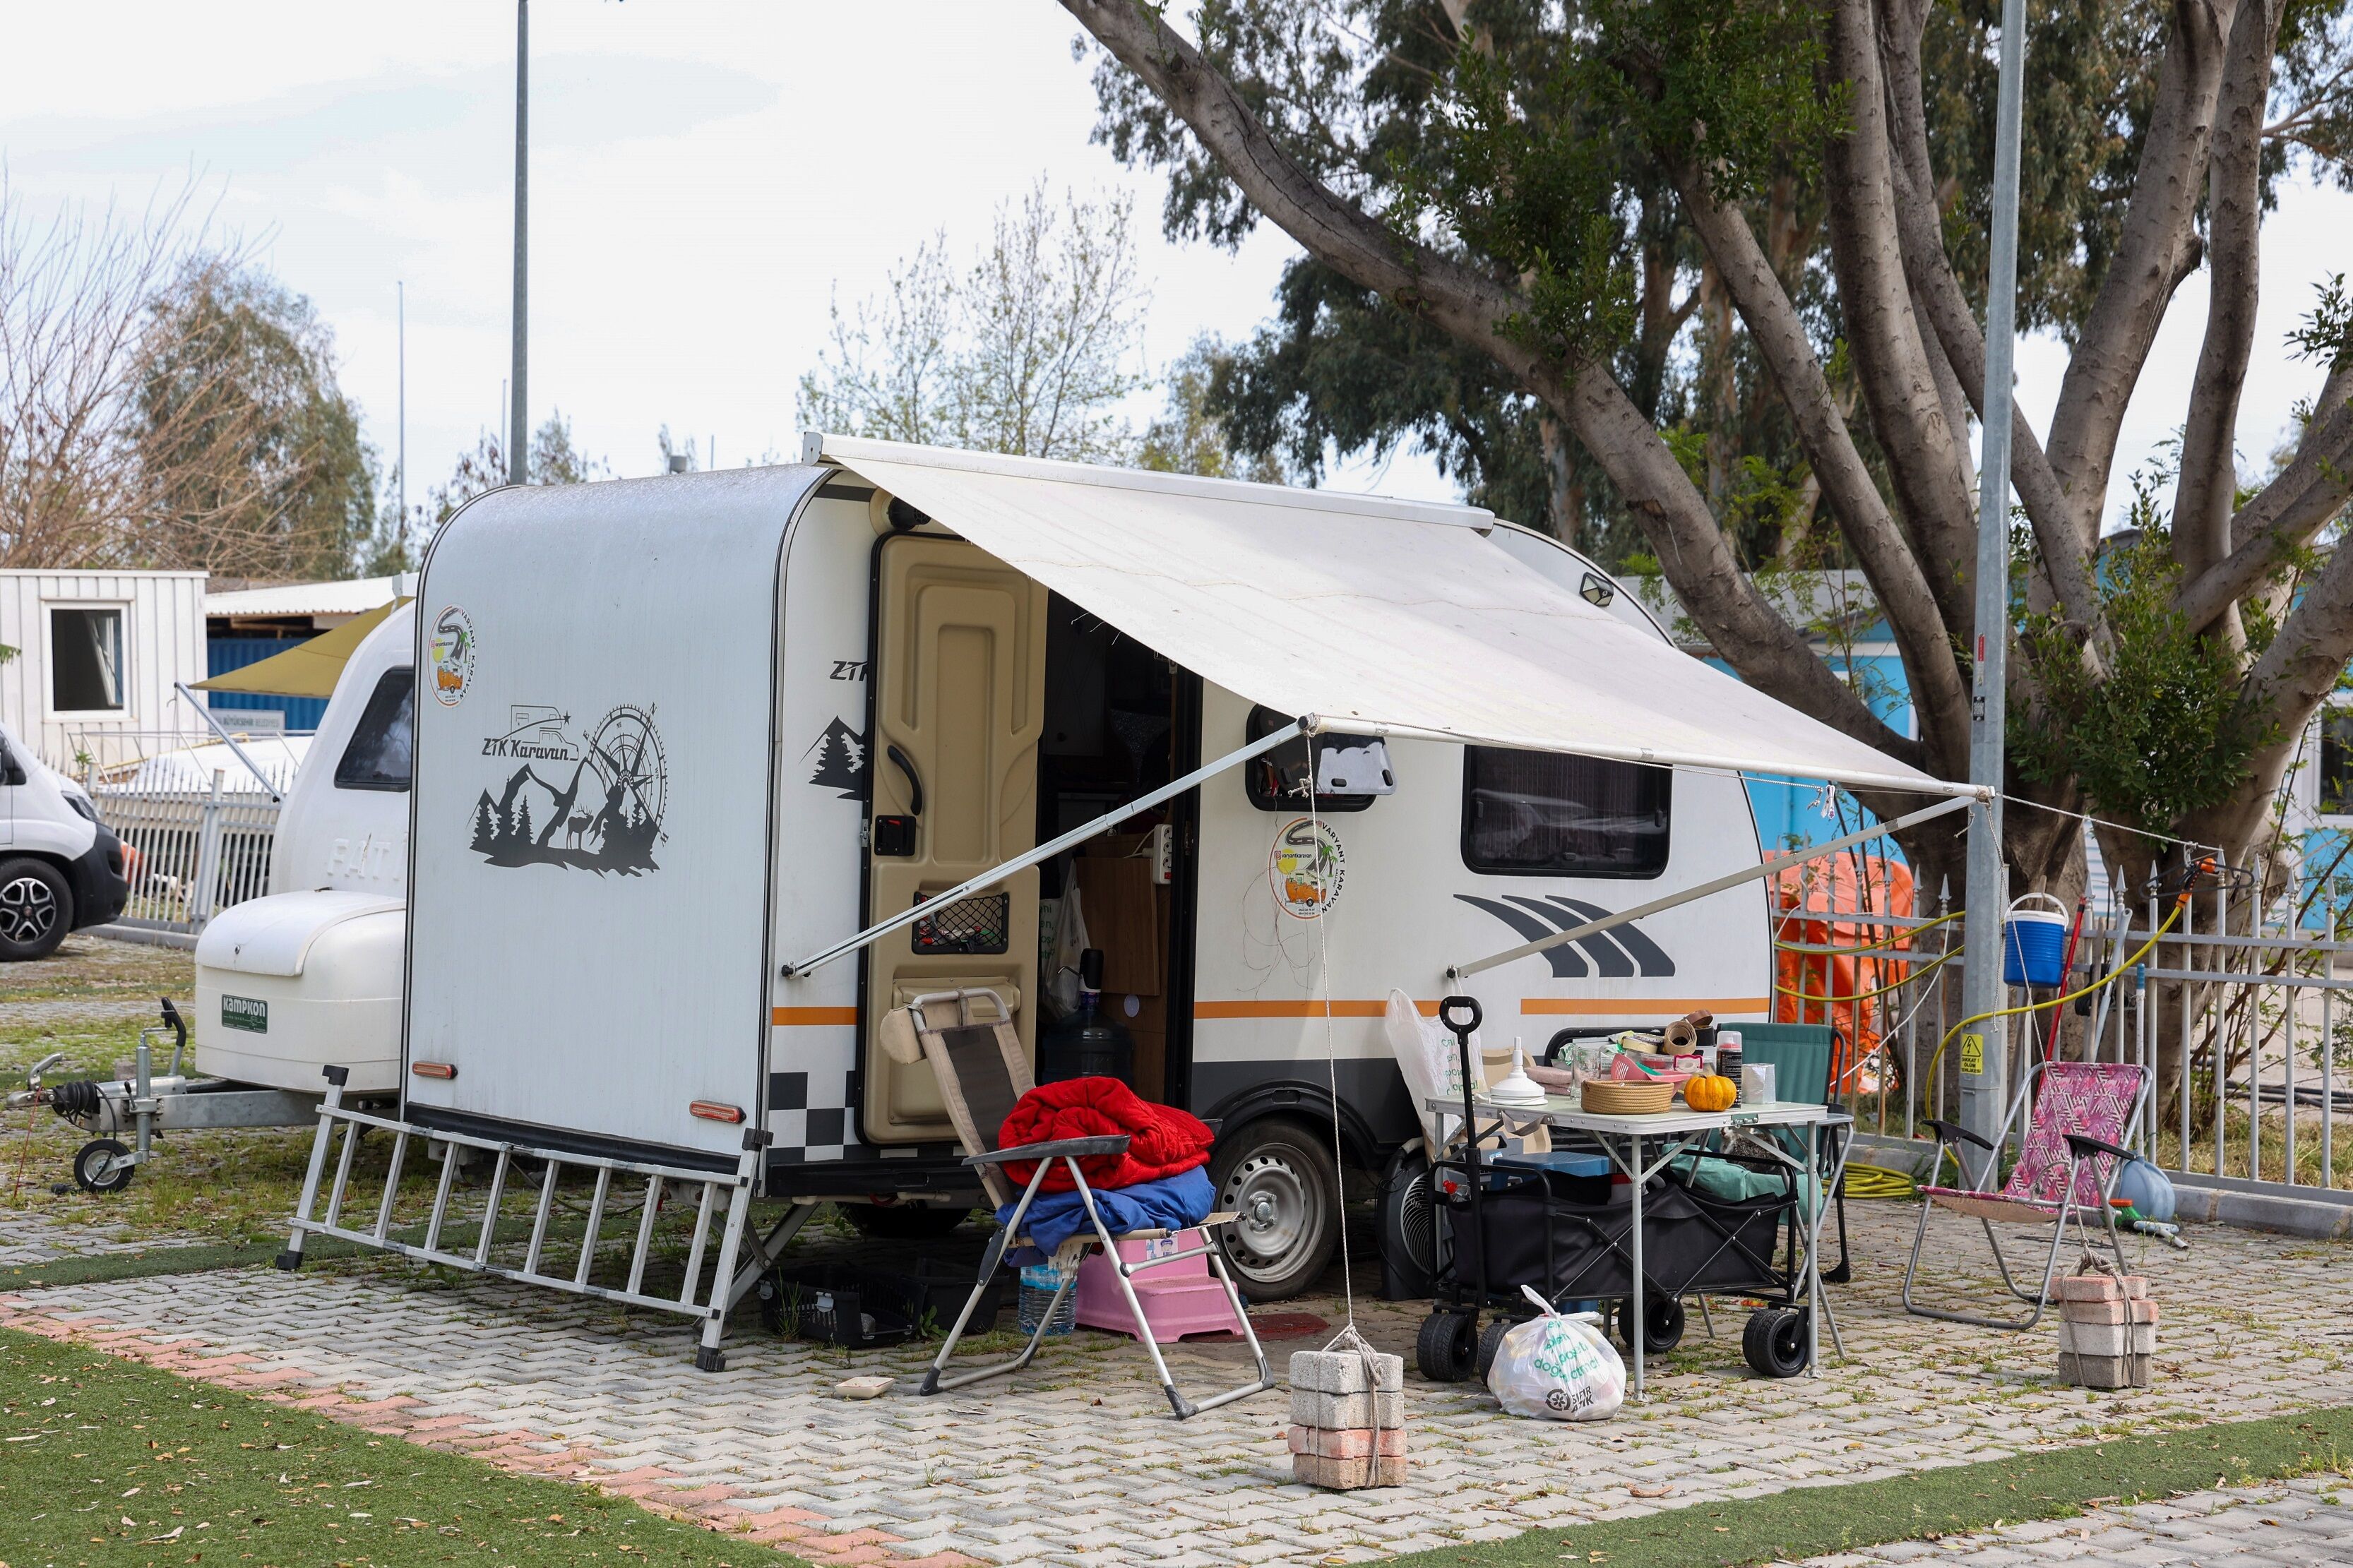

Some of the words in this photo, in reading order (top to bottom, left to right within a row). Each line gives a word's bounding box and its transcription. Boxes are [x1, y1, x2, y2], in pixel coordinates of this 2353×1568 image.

[461, 609, 475, 649] VARYANT
[460, 655, 475, 700] KARAVAN
[482, 738, 508, 757] ZTK
[510, 739, 569, 761] Karavan
[1321, 822, 1345, 864] VARYANT
[1321, 869, 1345, 914] KARAVAN
